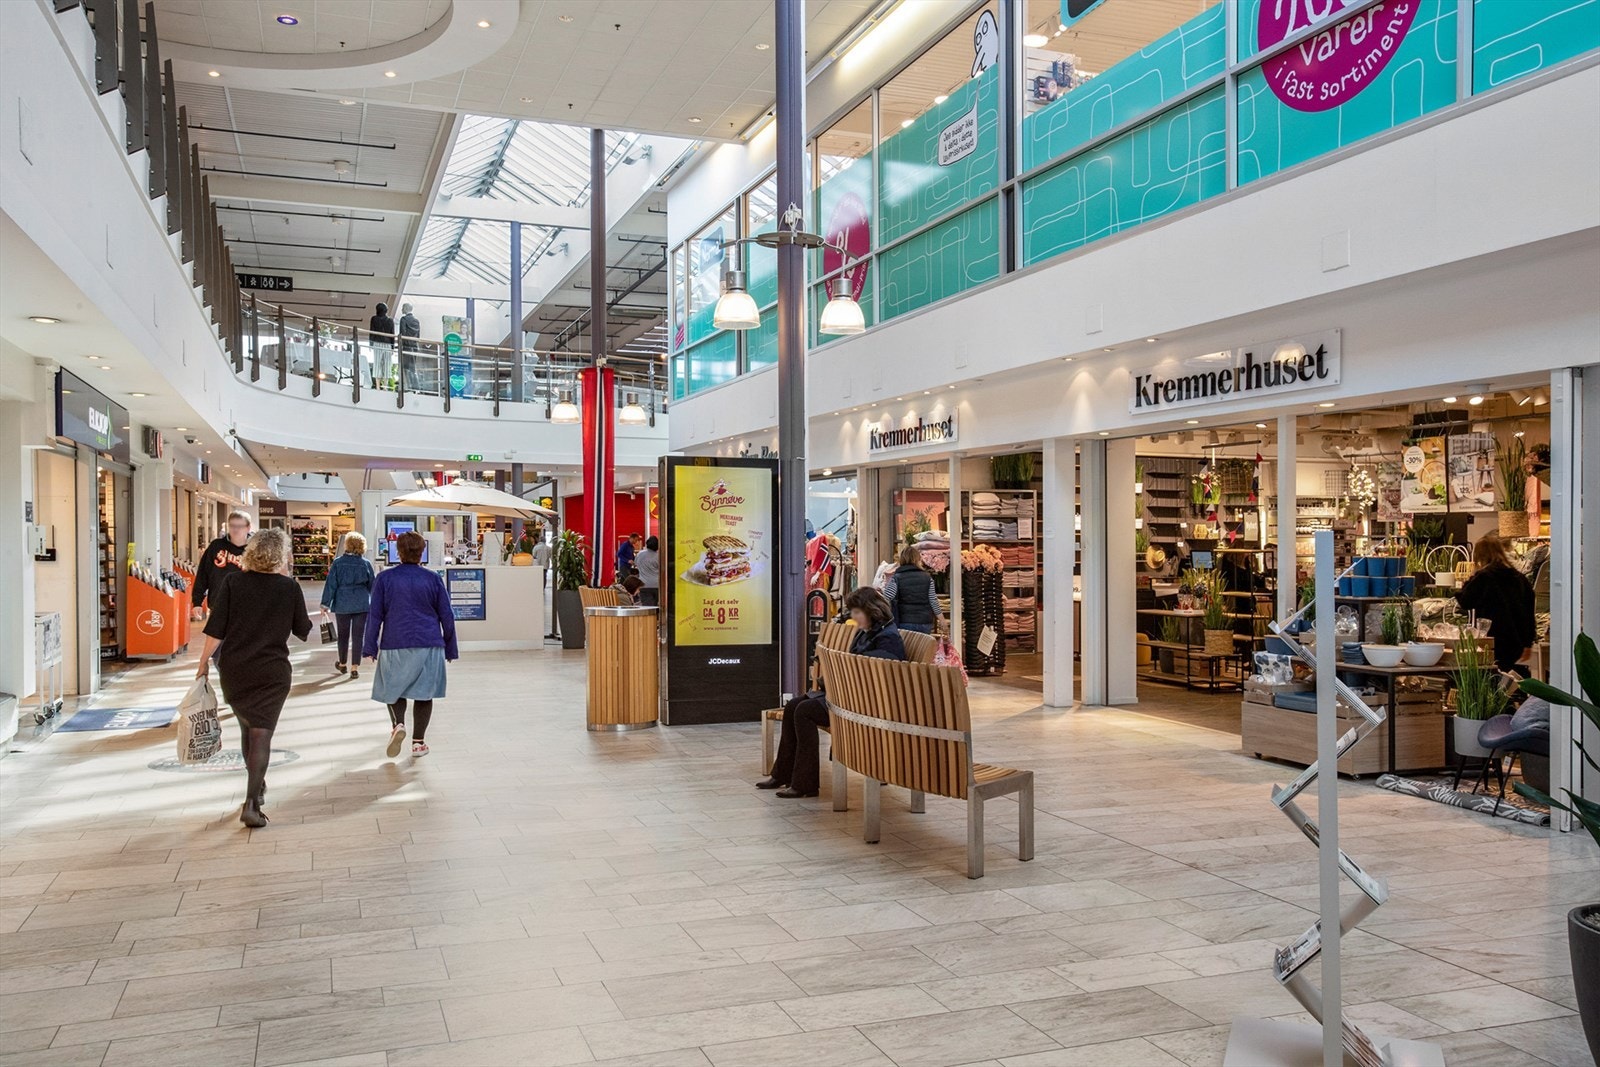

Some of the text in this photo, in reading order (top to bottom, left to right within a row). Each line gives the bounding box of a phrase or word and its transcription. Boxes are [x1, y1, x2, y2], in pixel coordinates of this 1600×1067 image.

[1275, 2, 1409, 101] i fast sortiment
[1134, 342, 1329, 408] Kremmerhuset
[869, 414, 954, 451] Kremmerhuset
[699, 495, 746, 514] Synnøve
[703, 607, 739, 625] CA. 8 KR
